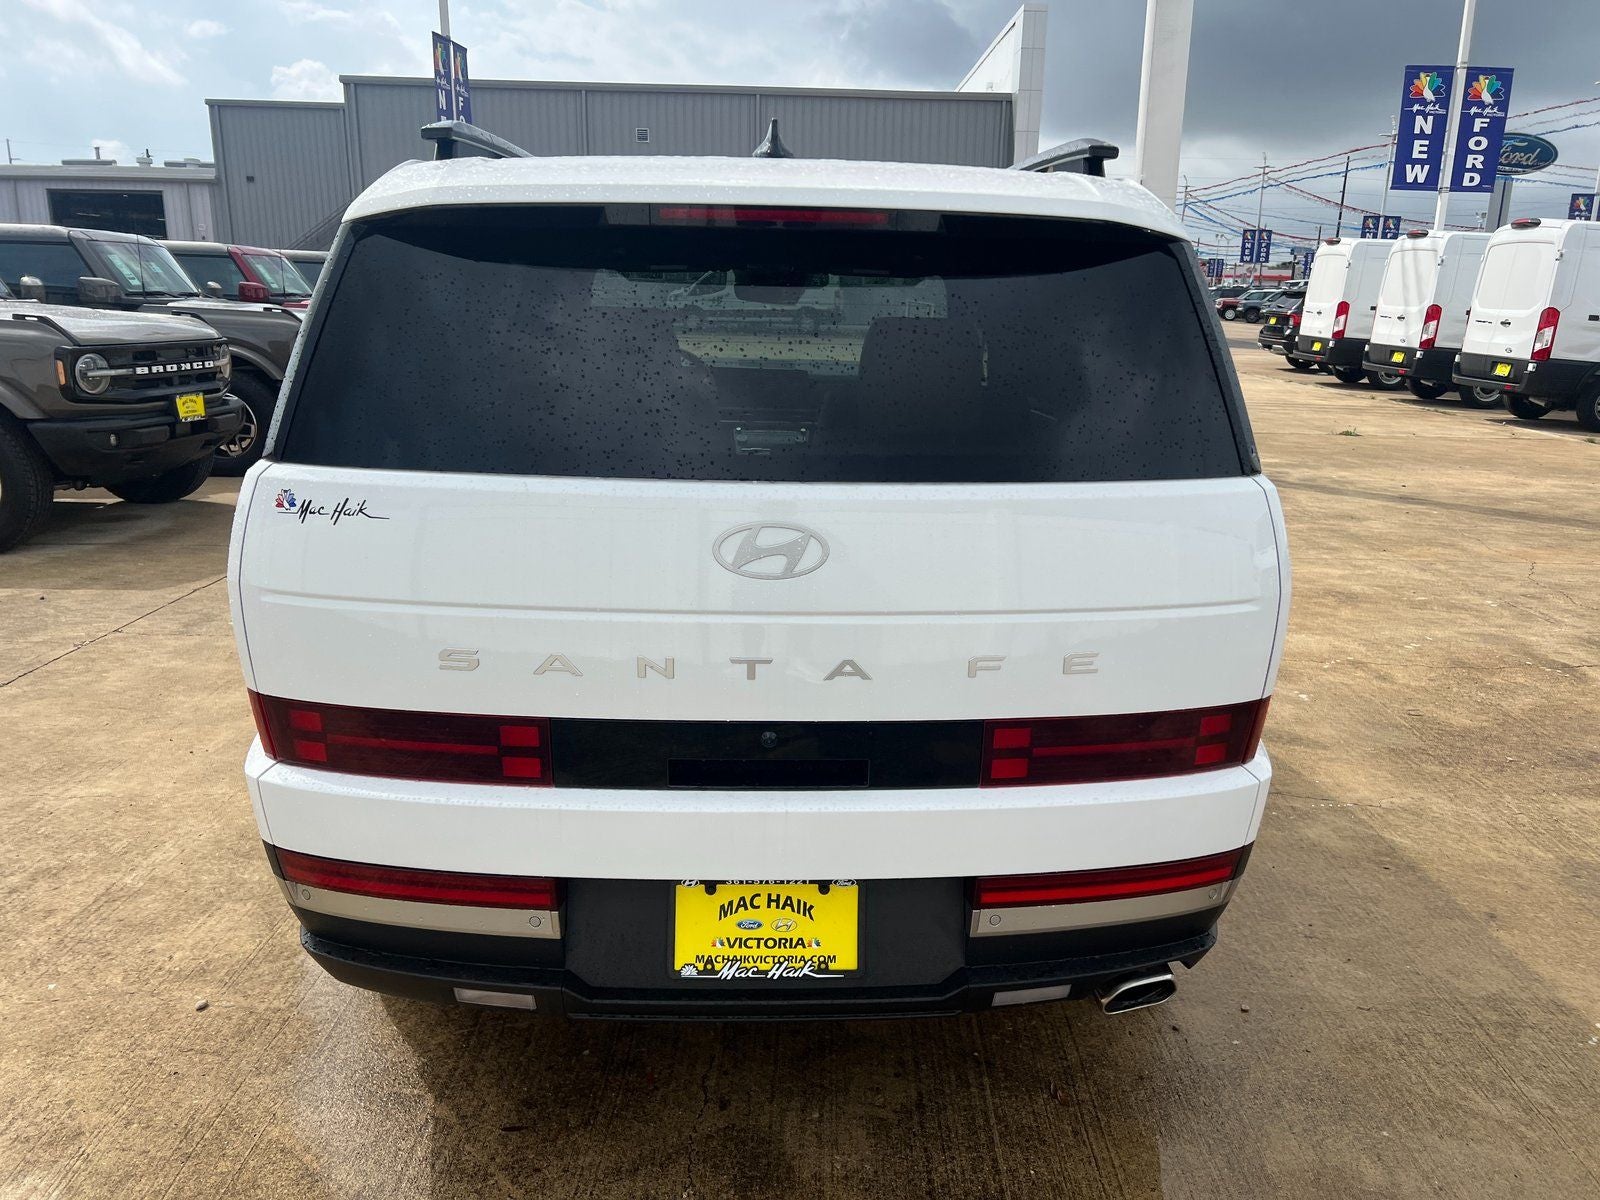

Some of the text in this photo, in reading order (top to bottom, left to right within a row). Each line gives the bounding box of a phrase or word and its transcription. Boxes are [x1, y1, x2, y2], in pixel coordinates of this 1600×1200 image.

[1405, 115, 1434, 184] NEW
[1462, 118, 1490, 187] FORD
[1499, 141, 1541, 165] Ford
[1243, 242, 1251, 262] NEW
[1259, 242, 1268, 262] FORD
[135, 360, 215, 375] BRONCO
[291, 497, 380, 526] Mac Haik
[438, 648, 1100, 682] SANTA FE
[719, 893, 815, 921] MAC HAIK
[725, 937, 807, 949] VICTORIA
[695, 954, 837, 964] MACHAIKVICTORIACOM
[706, 960, 831, 980] Mac Haik
